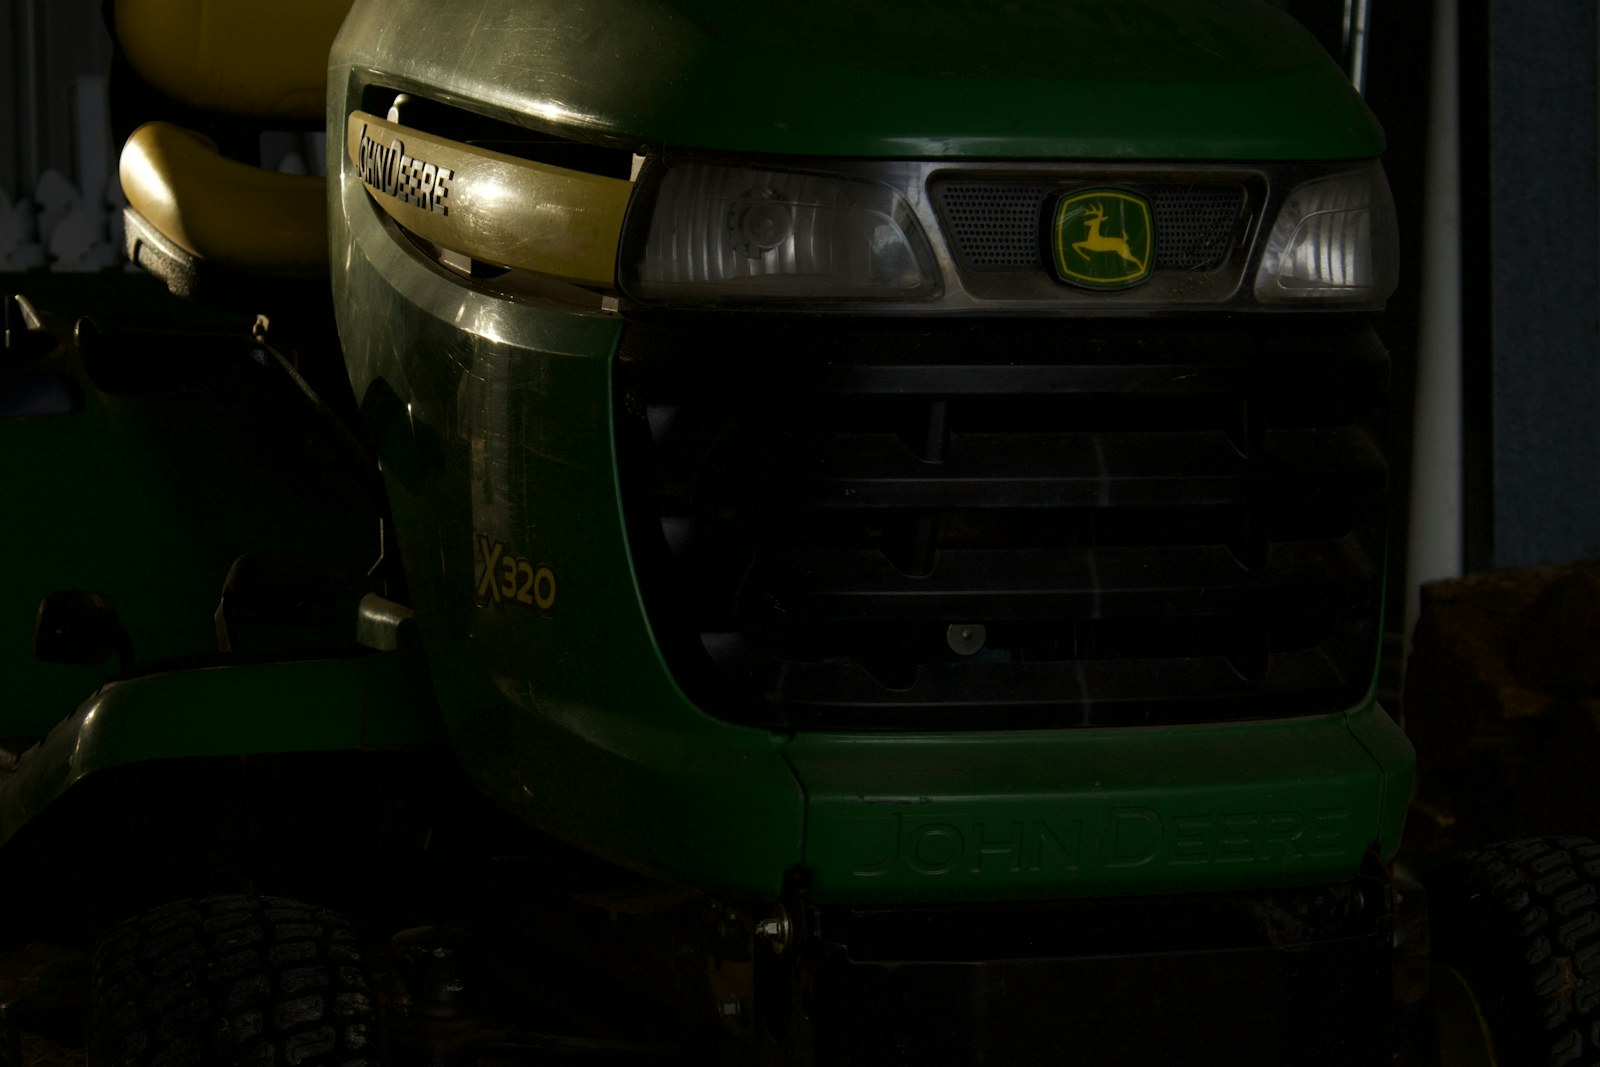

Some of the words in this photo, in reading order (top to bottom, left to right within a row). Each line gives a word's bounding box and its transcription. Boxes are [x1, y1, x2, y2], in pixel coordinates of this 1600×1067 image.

[385, 139, 454, 216] DEERE
[476, 534, 557, 612] X320
[852, 812, 1084, 877] JOHN
[1104, 804, 1350, 870] DEERE
